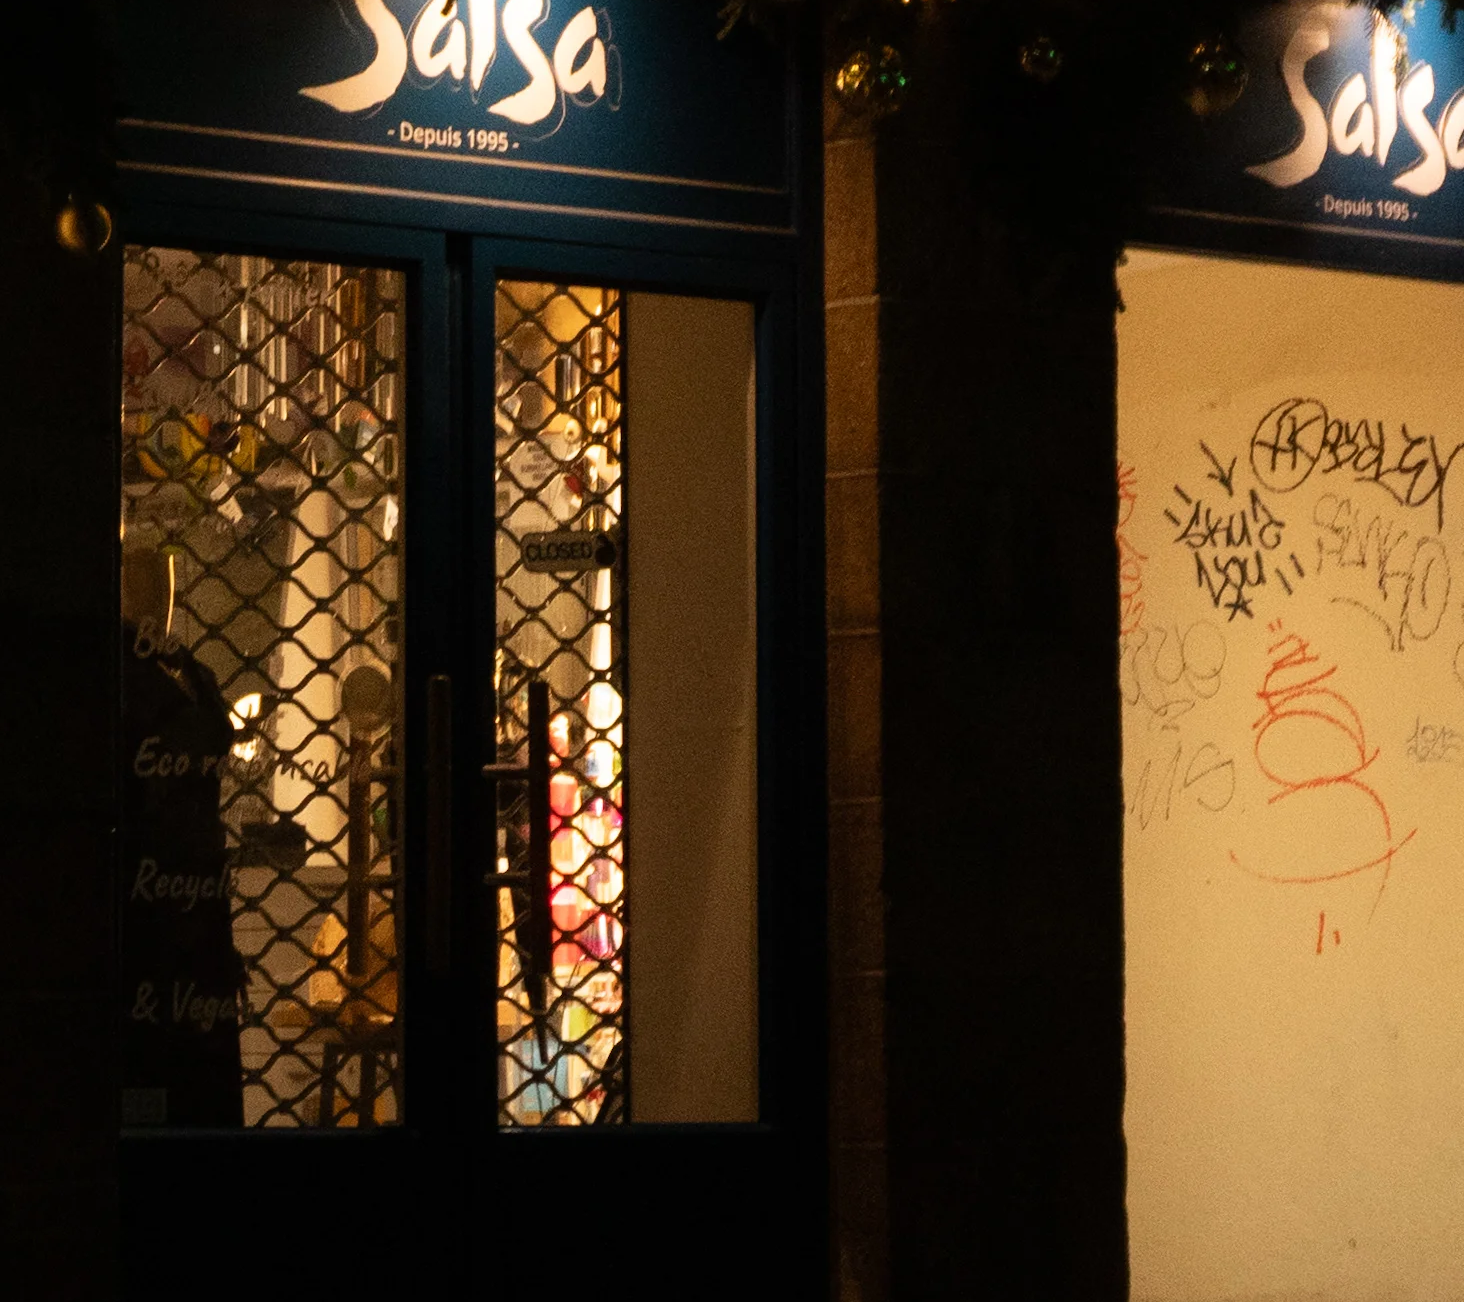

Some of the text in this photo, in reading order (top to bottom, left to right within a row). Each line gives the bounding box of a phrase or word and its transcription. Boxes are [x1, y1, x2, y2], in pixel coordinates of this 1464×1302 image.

[399, 121, 509, 153] Depuis 1995
[1323, 194, 1409, 221] Depuis 1995
[525, 541, 593, 563] CLOSED
[133, 734, 192, 780] Eco
[130, 980, 162, 1025] &
